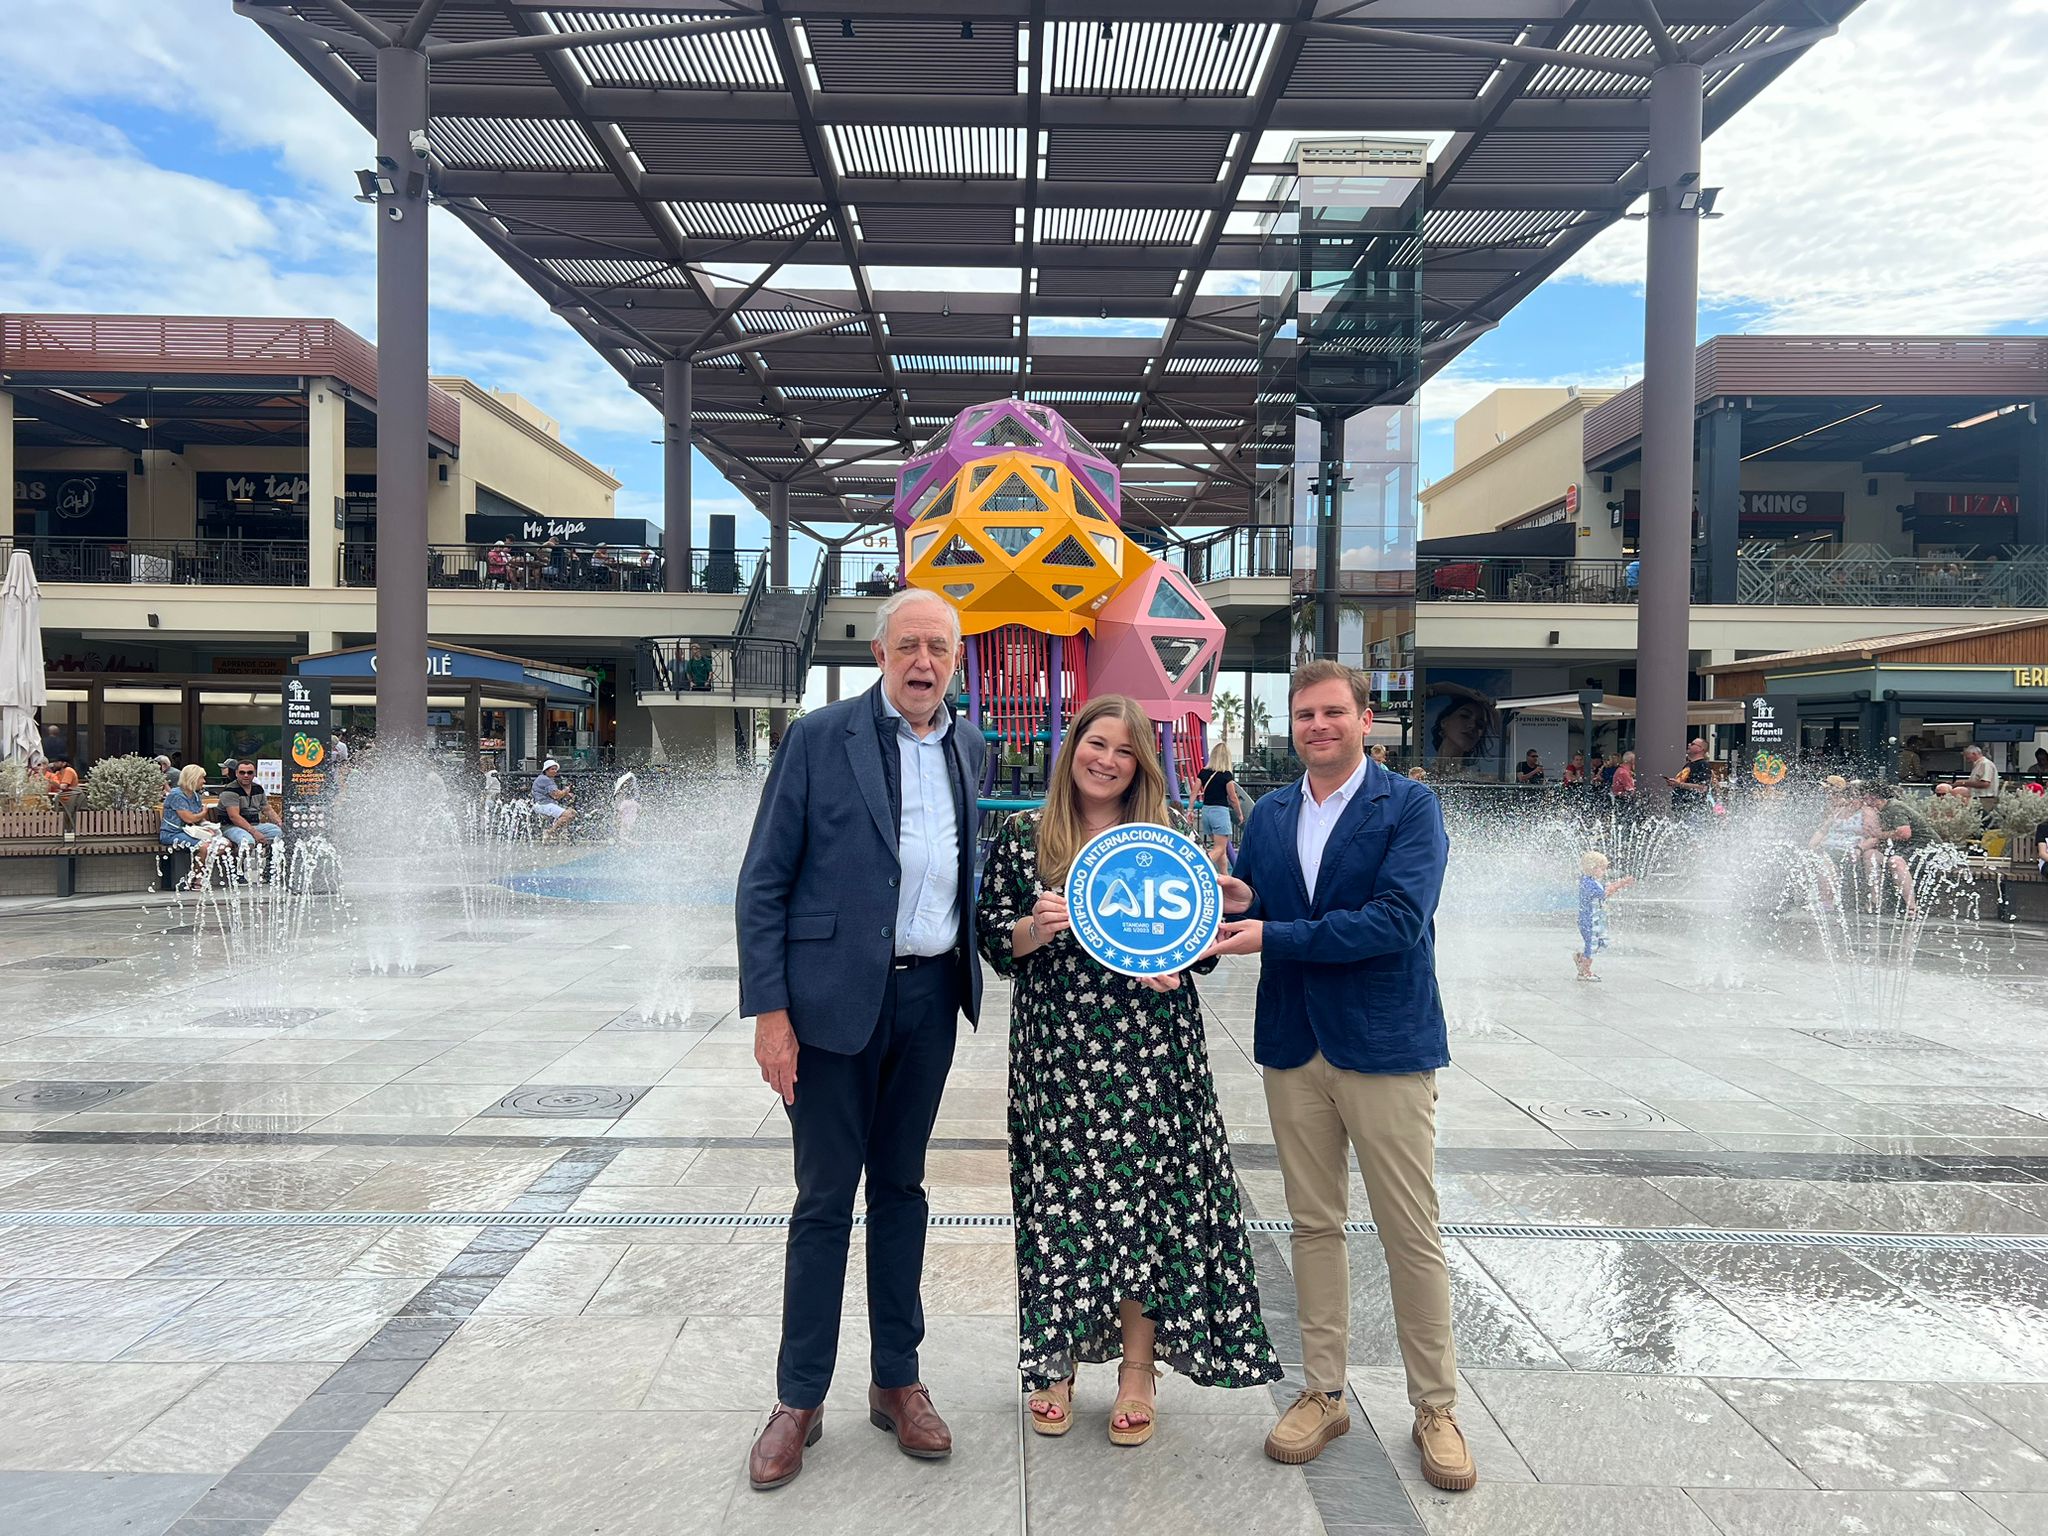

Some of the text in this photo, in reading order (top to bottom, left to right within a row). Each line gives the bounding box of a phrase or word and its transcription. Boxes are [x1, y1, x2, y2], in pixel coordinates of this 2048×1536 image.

[226, 475, 309, 504] My tap
[1751, 494, 1808, 514] KING
[523, 519, 586, 541] My tapa
[2013, 667, 2048, 687] TER
[288, 703, 311, 711] Zona
[1751, 720, 1774, 728] Zona
[1073, 829, 1215, 953] CERTIFICADO INTERNACIONAL DE ACCESIBILIDAD
[1097, 878, 1191, 920] AIS
